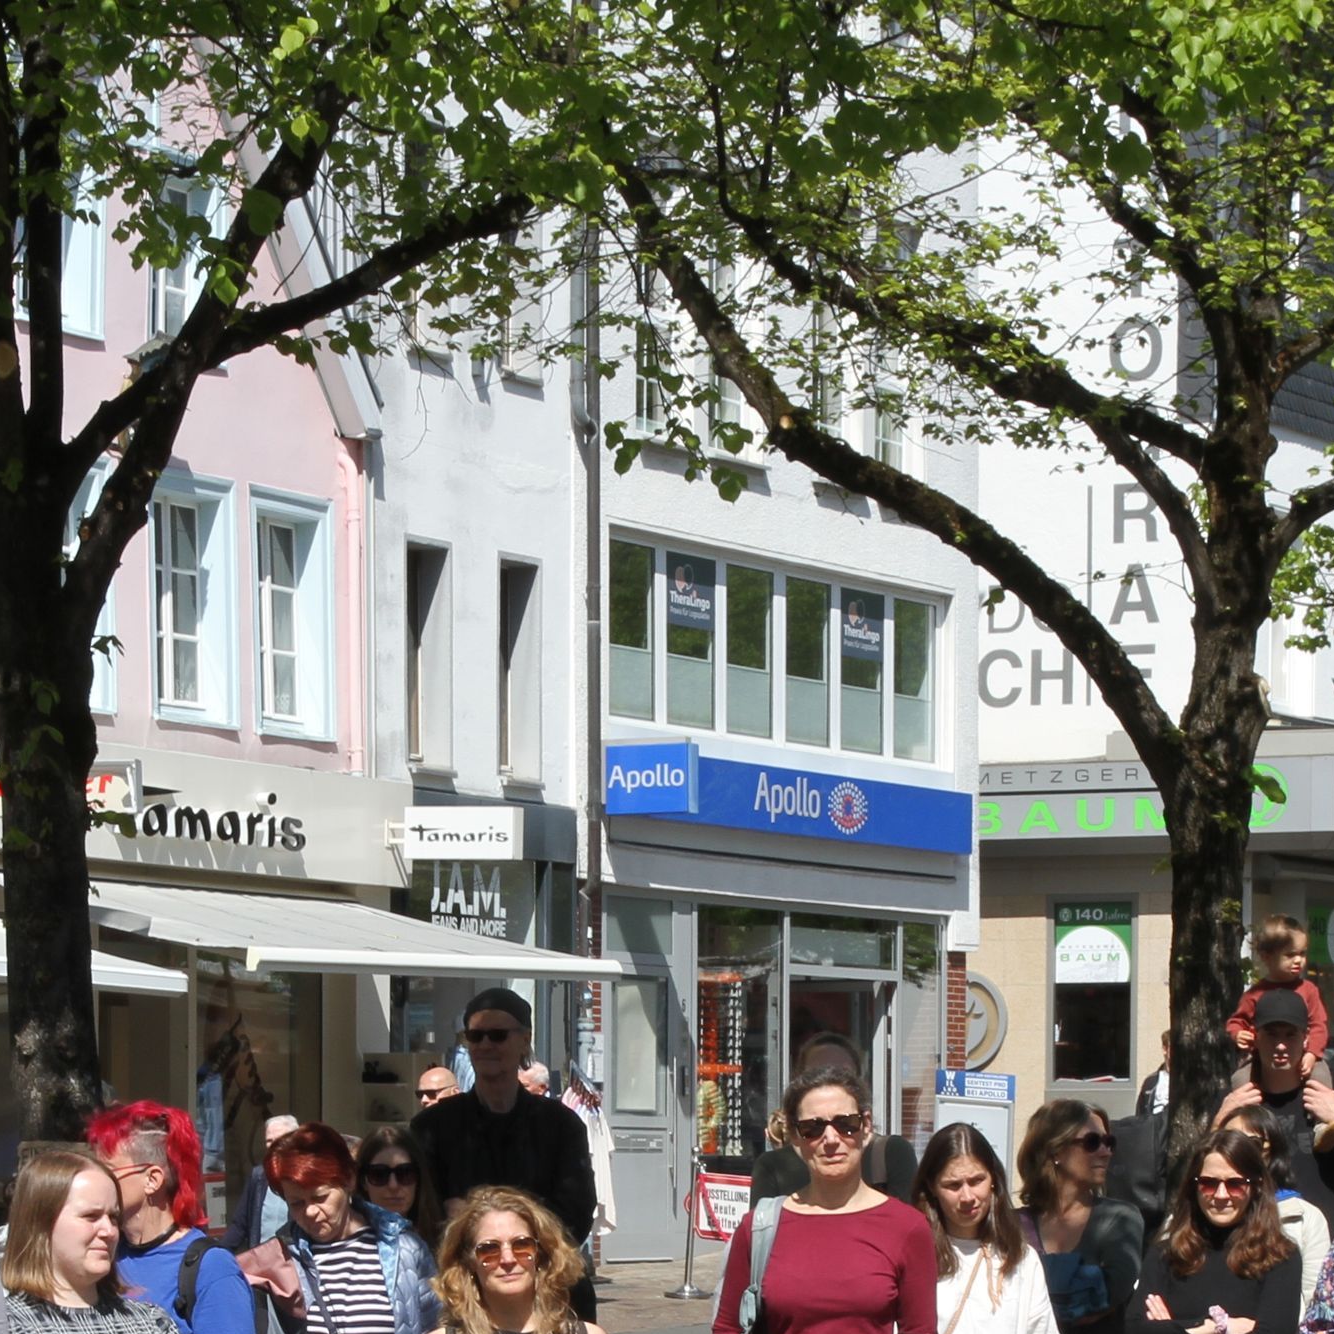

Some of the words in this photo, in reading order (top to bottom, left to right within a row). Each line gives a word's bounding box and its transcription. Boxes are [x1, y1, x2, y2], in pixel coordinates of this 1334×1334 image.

[608, 763, 685, 793] Apollo
[754, 771, 821, 823] Apollo
[1074, 908, 1103, 921] 140
[479, 920, 507, 937] MORE
[1059, 953, 1121, 962] BAUM
[979, 1090, 1006, 1098] APOLLO
